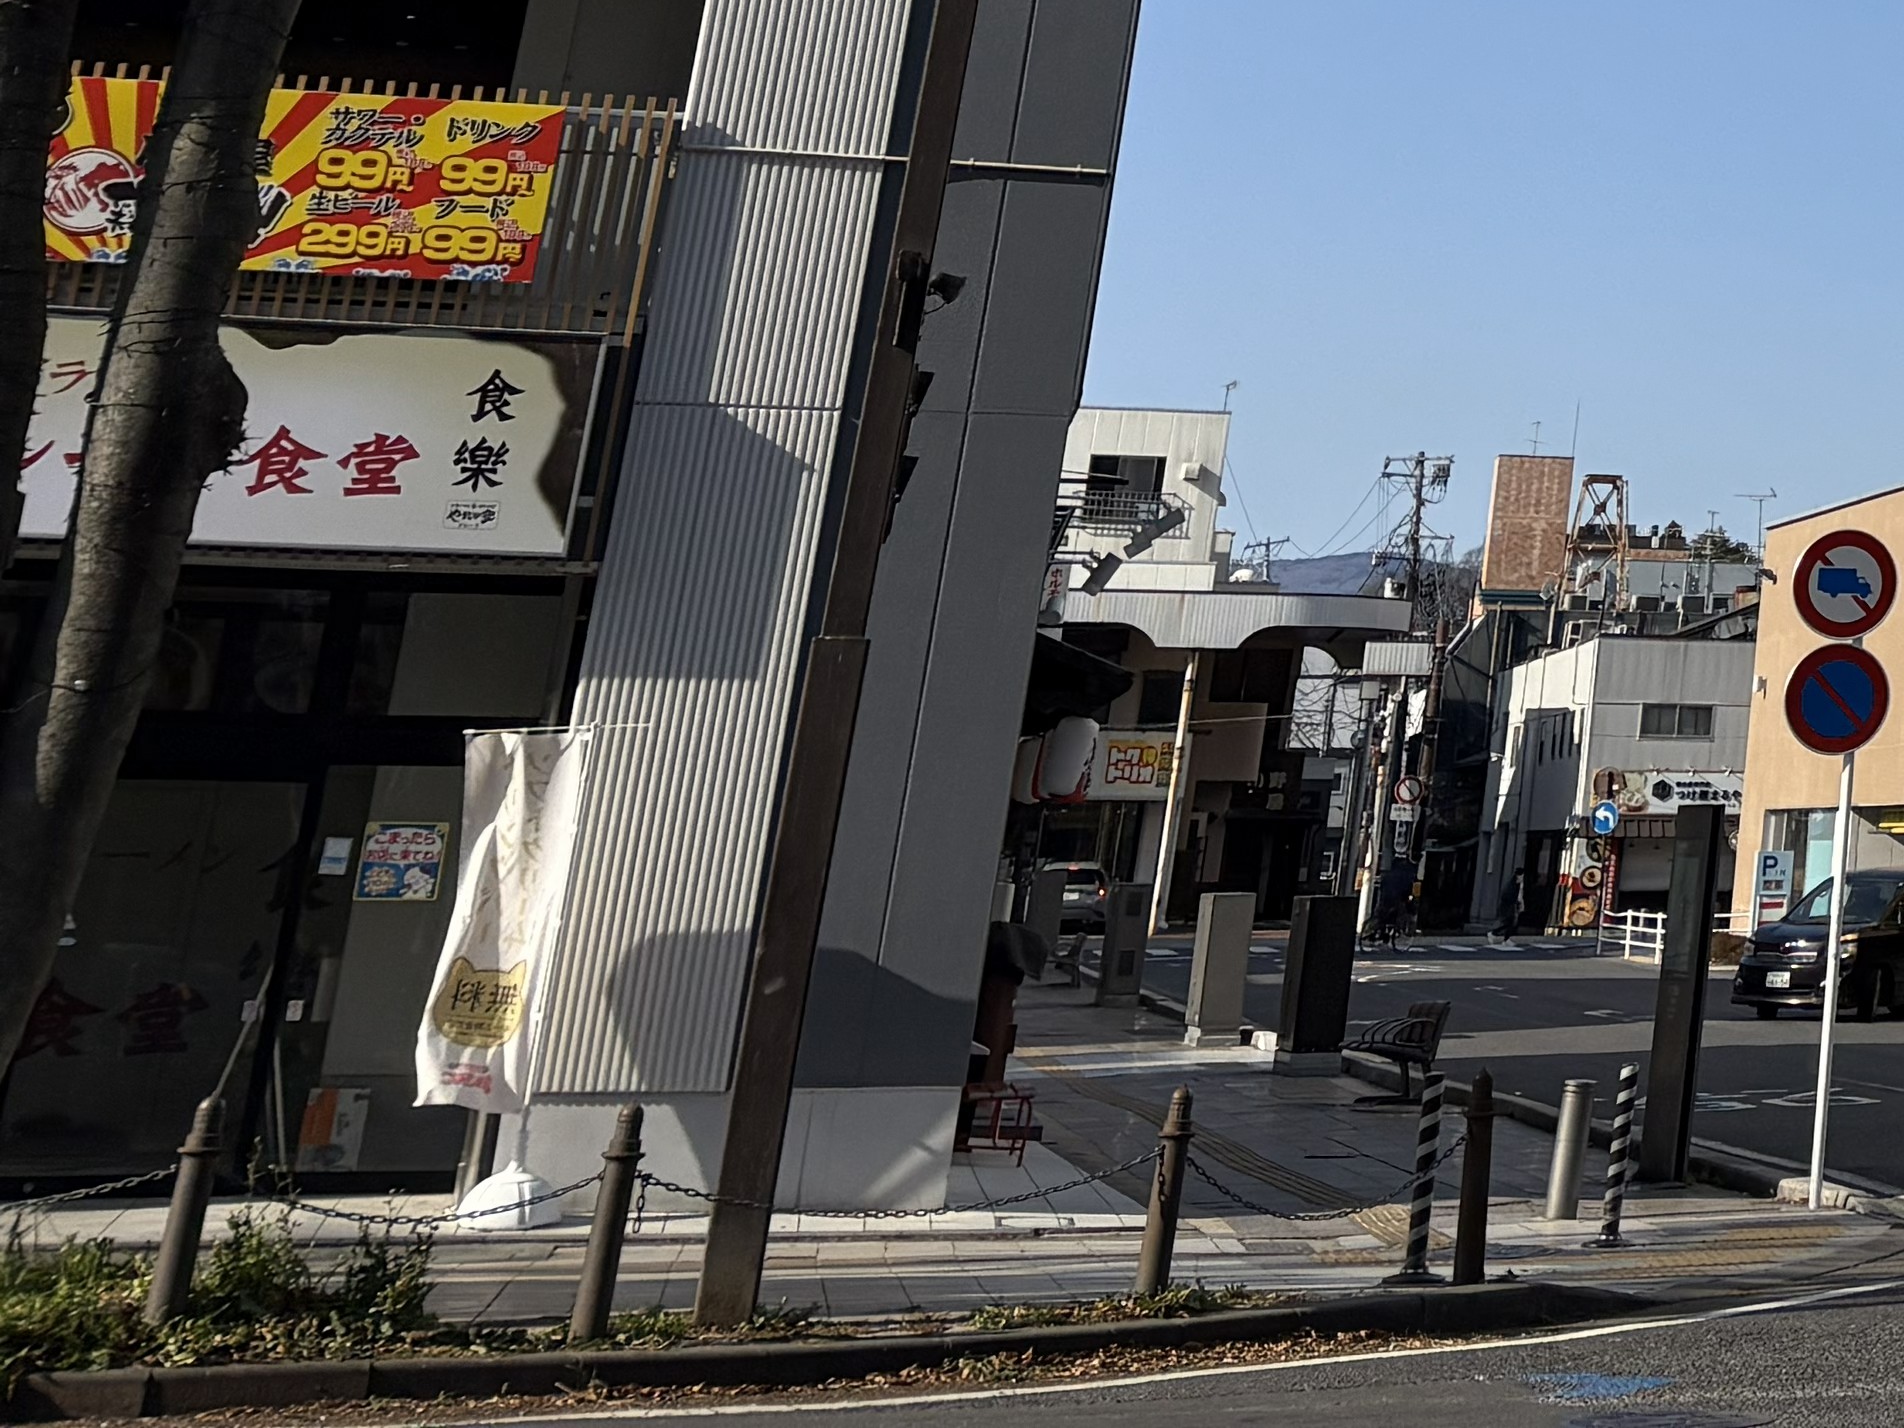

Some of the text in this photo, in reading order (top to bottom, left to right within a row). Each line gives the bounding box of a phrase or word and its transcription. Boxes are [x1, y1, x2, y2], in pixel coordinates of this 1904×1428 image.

[321, 127, 424, 148] カクテル
[446, 117, 541, 144] ドリンク
[306, 190, 401, 215] 生ビール
[431, 196, 514, 221] フード
[1762, 855, 1779, 877] P
